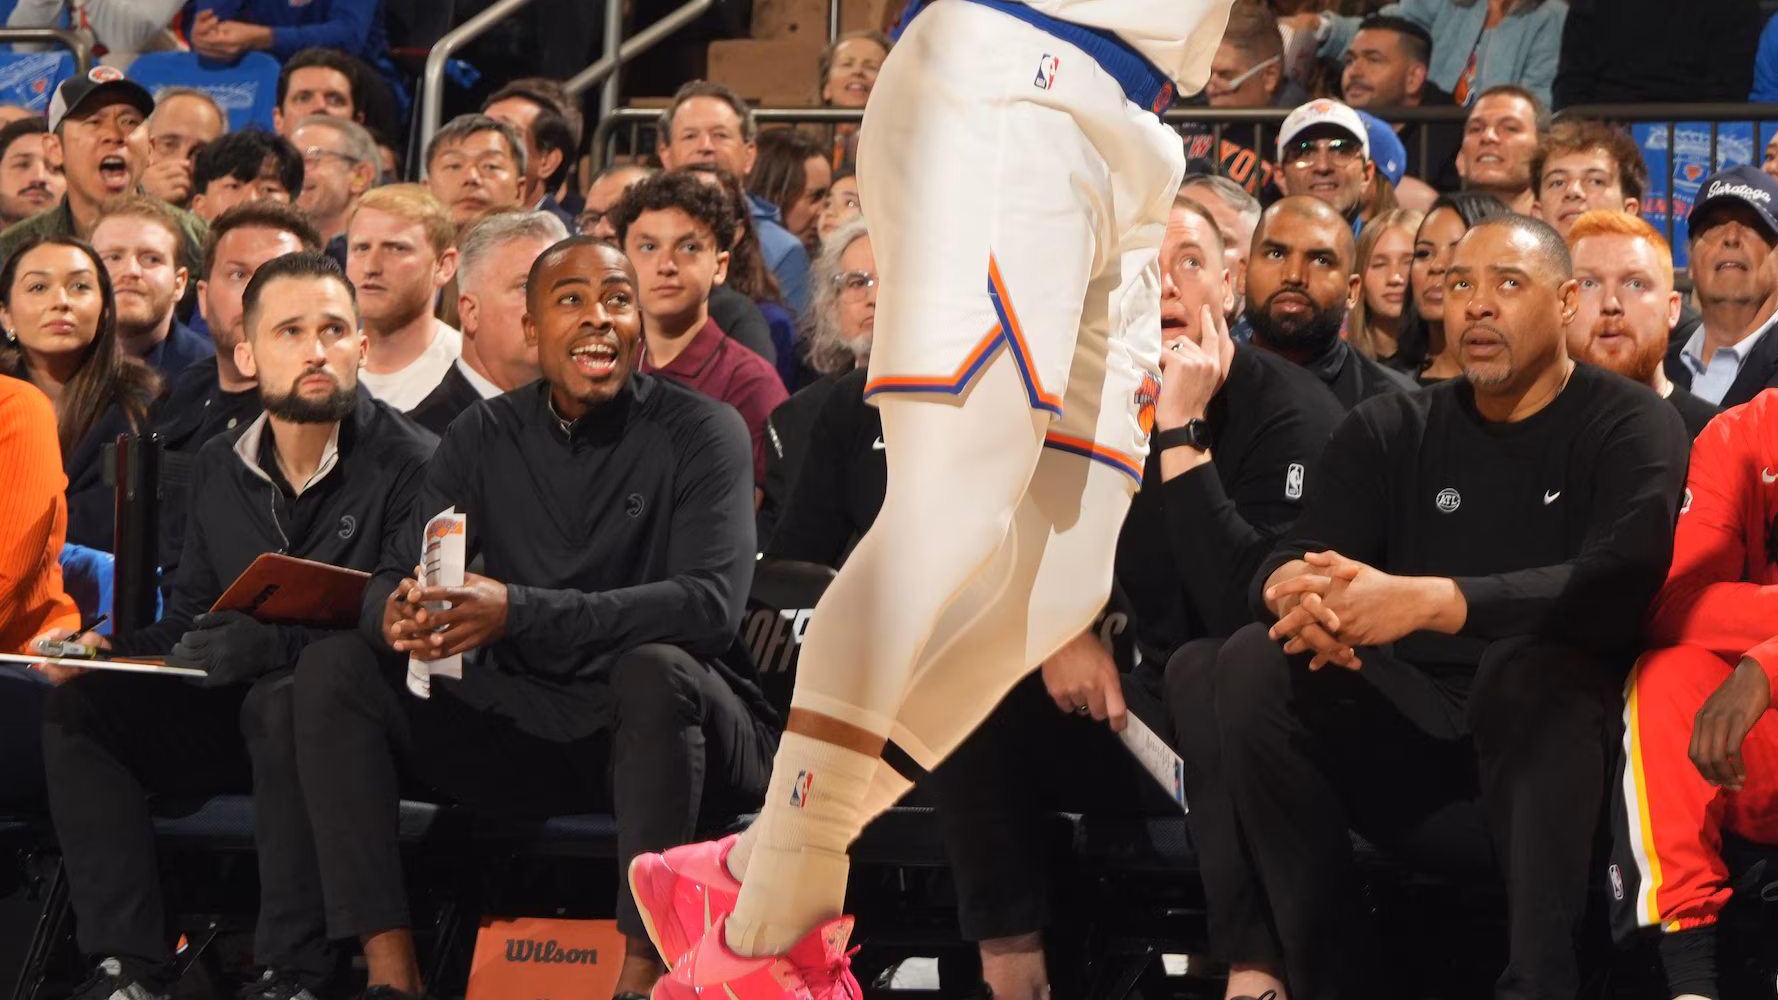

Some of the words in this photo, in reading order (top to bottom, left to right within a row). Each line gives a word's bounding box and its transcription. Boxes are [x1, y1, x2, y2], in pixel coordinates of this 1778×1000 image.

[1706, 180, 1772, 204] Saratoga
[1438, 493, 1459, 506] ATL
[505, 938, 599, 965] Wilson
